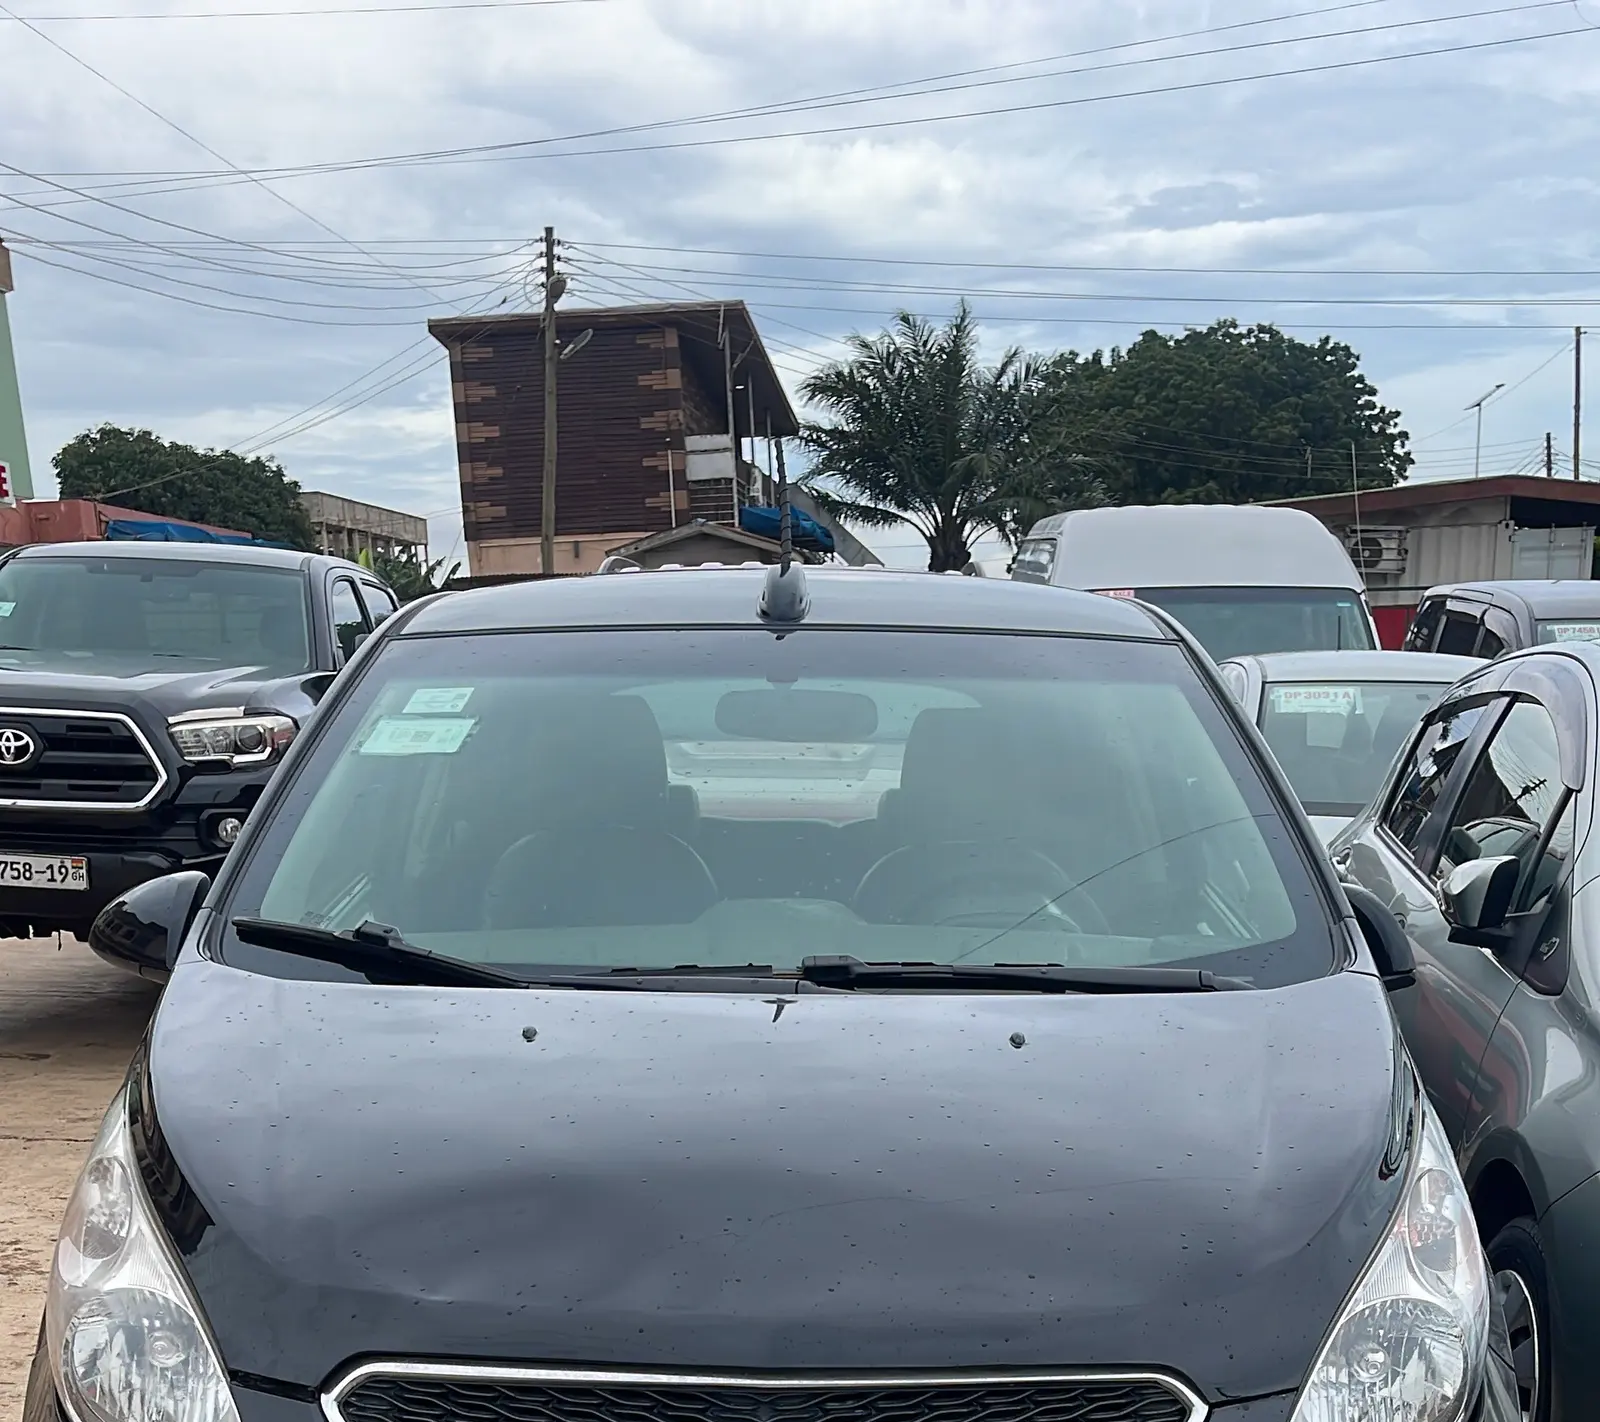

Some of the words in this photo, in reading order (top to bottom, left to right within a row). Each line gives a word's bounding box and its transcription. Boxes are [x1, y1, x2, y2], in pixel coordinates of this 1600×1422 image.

[1284, 691, 1301, 699] DP
[1342, 691, 1351, 700] A
[0, 861, 69, 883] 758-19
[72, 872, 84, 881] GH
